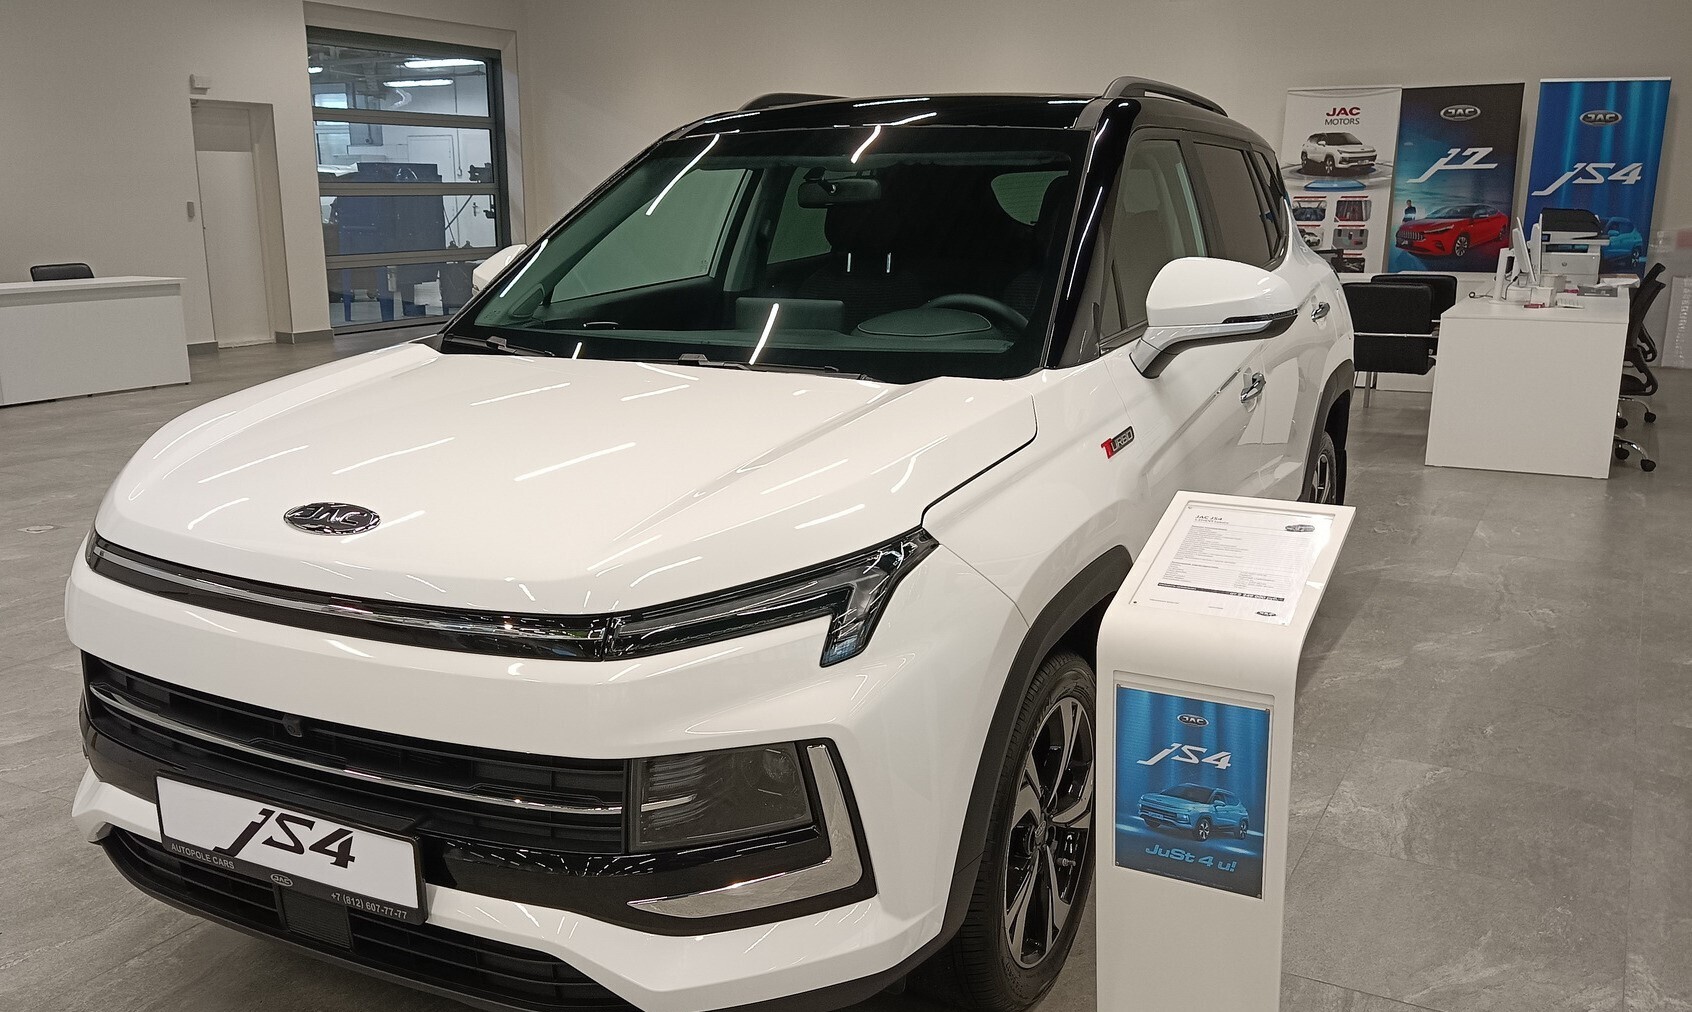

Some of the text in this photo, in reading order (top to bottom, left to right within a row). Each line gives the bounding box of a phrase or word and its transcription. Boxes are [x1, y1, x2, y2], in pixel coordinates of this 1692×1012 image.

[1324, 118, 1360, 126] MOTORS
[1325, 106, 1361, 117] JAC
[1101, 427, 1134, 459] TURBO
[171, 842, 235, 870] AUTOPOLE CARS
[1198, 854, 1214, 868] 4
[1217, 860, 1238, 873] u!
[331, 892, 408, 920] +7 (812) 607-77-77
